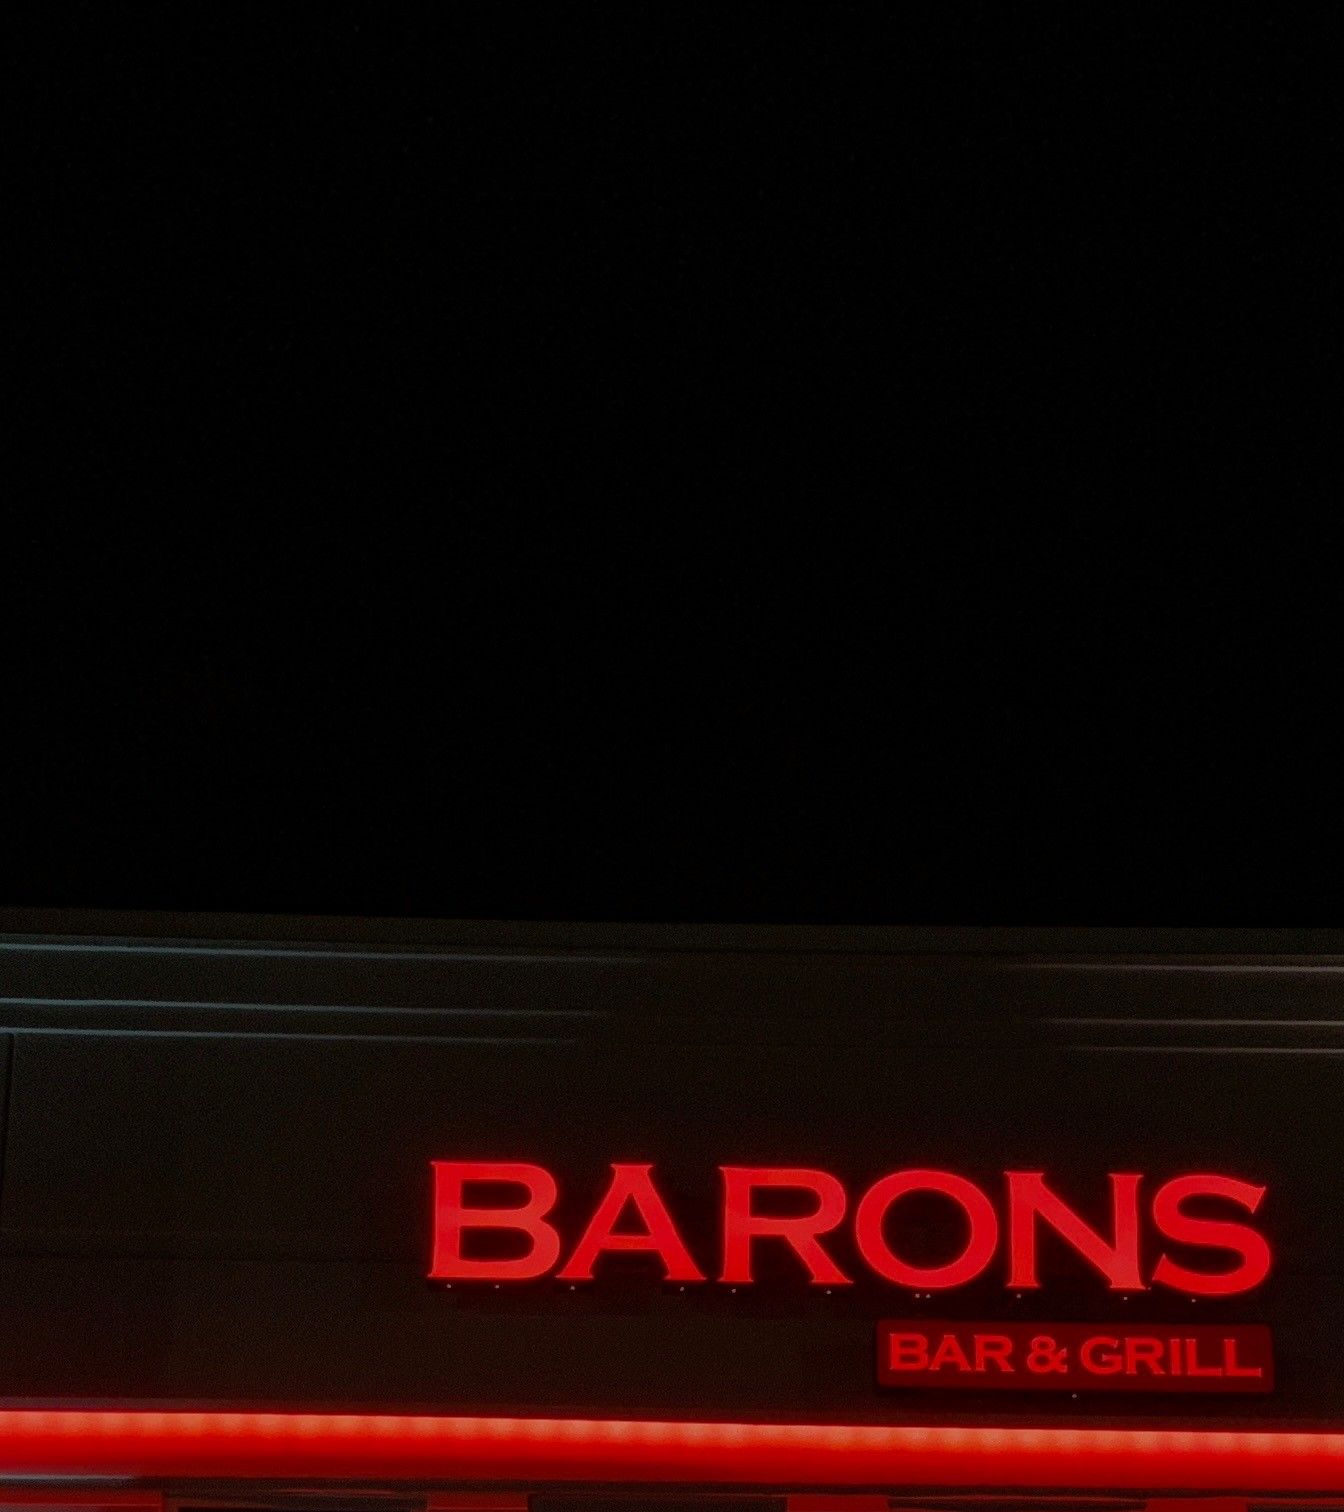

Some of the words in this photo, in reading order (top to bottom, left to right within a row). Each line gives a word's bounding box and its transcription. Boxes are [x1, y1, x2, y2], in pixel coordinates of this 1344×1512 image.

[428, 1161, 1271, 1296] BARONS
[889, 1334, 1013, 1373] BAR
[1026, 1335, 1069, 1374] &
[1081, 1337, 1263, 1379] GRILL
